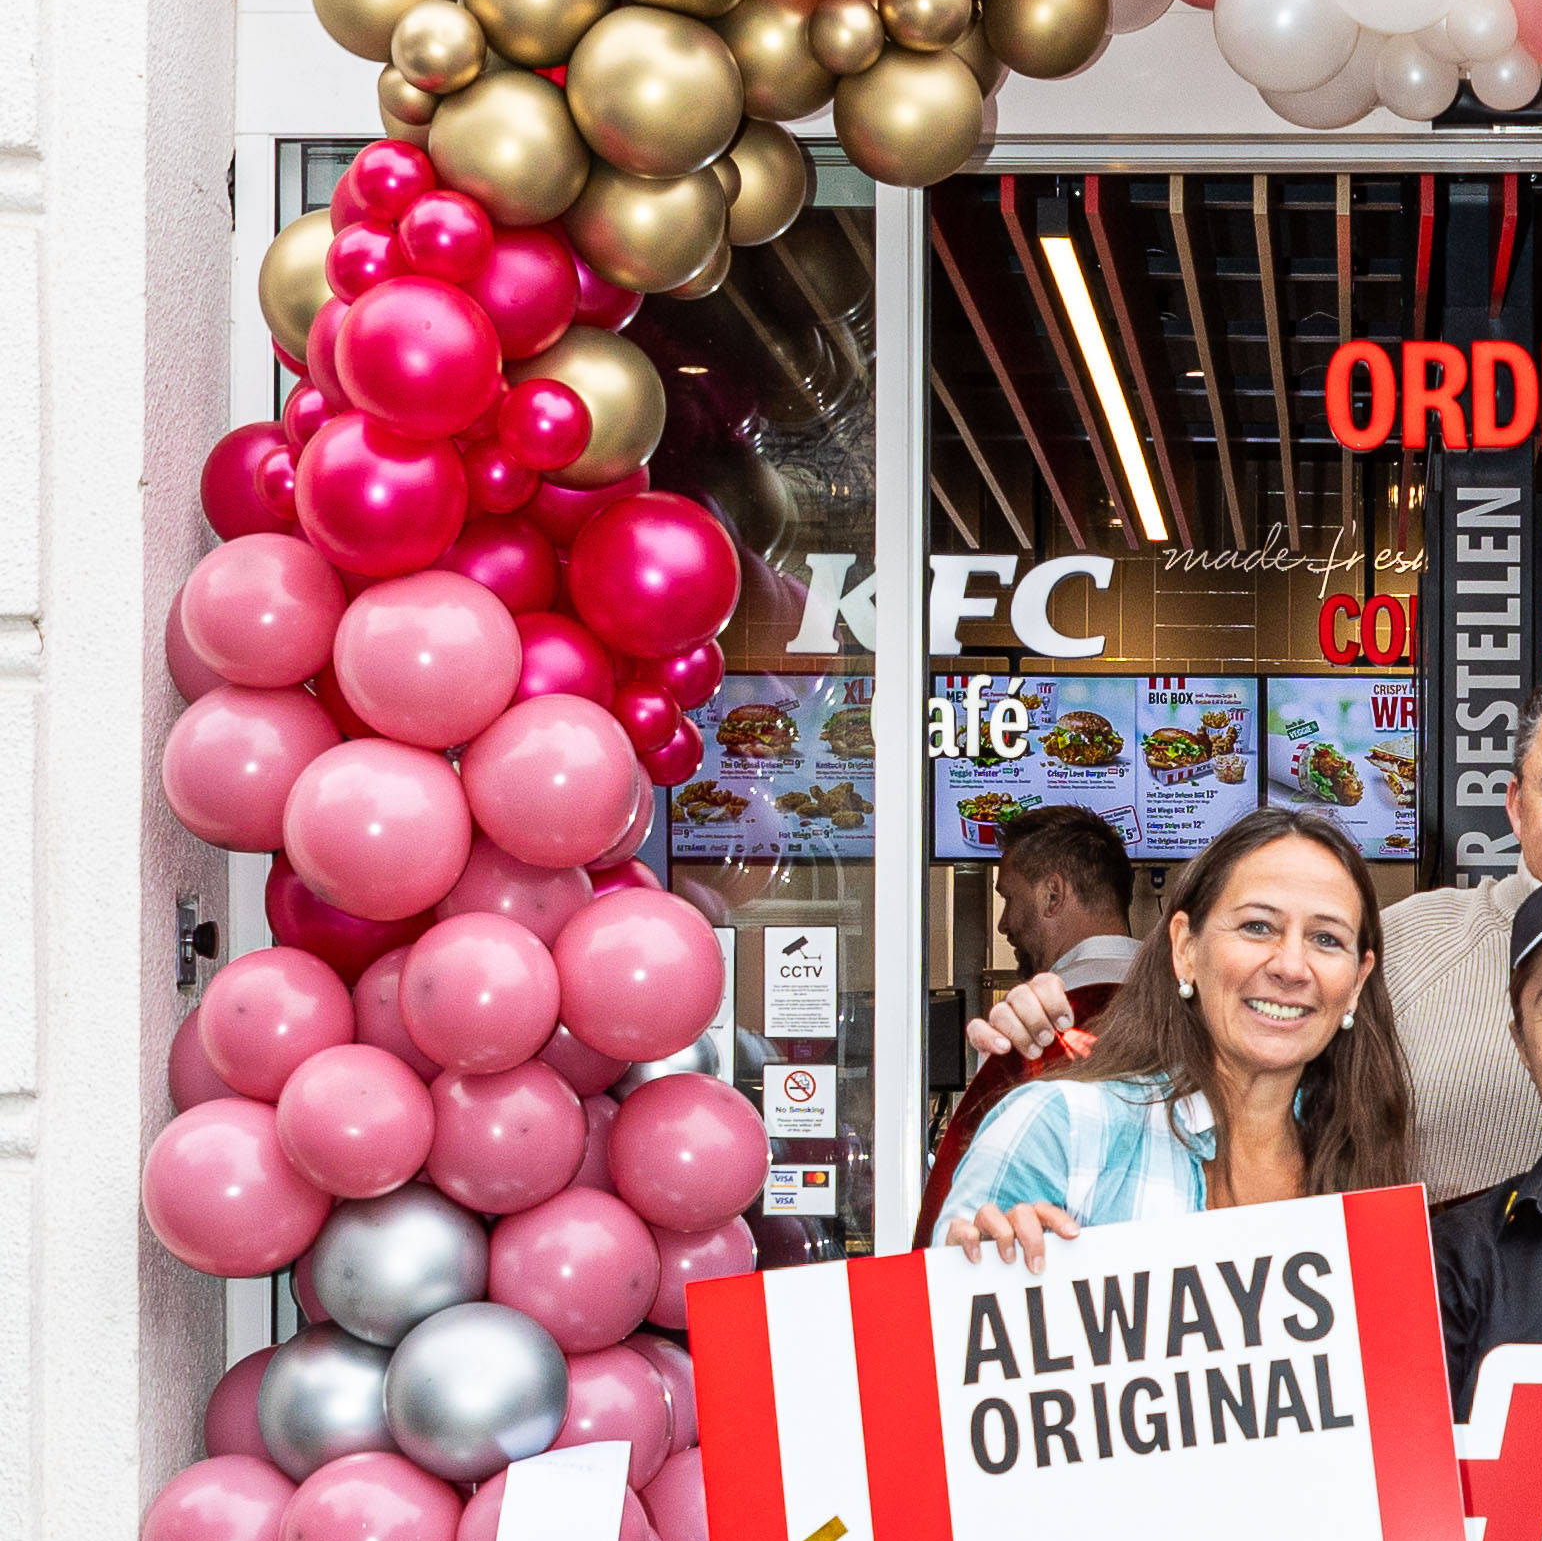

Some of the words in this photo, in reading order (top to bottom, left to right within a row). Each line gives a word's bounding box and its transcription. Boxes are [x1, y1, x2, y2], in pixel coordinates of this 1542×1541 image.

[1163, 521, 1306, 572] made
[786, 553, 1114, 658] KFC
[1456, 487, 1521, 807] BESTELLEN
[1149, 692, 1168, 705] BIG
[1170, 692, 1193, 705] BOX
[1373, 684, 1408, 695] CRISPY
[870, 674, 1029, 758] afé
[1371, 696, 1417, 729] WR
[780, 965, 823, 978] CCTV
[775, 1106, 787, 1114] No
[789, 1106, 825, 1115] Smoking
[775, 1197, 795, 1205] VISA
[963, 1251, 1335, 1386] ALWAYS
[969, 1353, 1355, 1476] ORIGINAL
